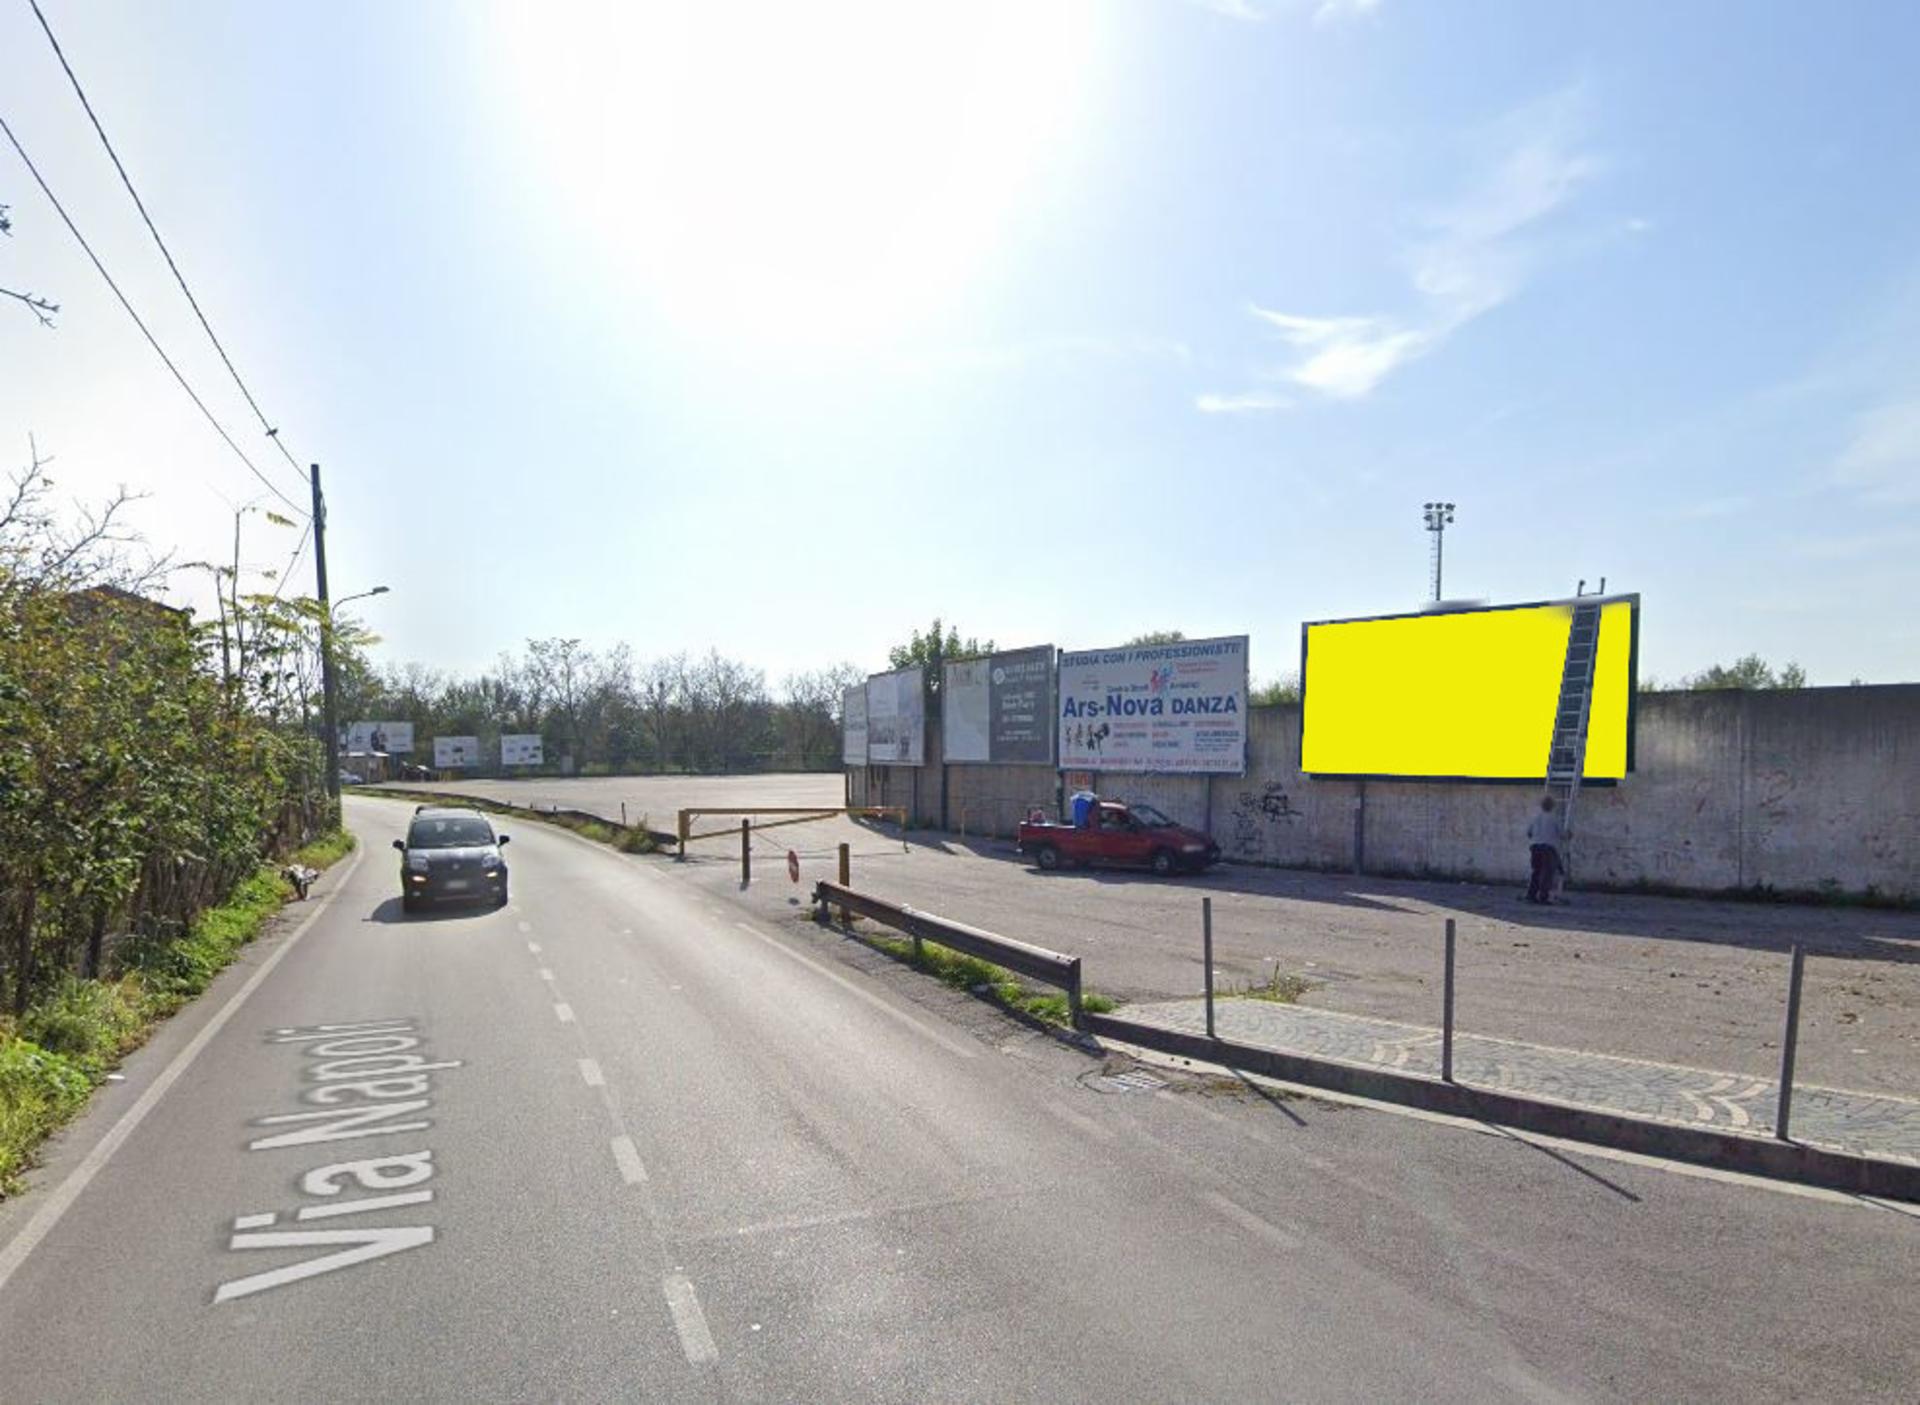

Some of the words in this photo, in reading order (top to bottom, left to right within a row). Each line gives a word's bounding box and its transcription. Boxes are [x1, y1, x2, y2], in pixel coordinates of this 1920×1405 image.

[1103, 653, 1126, 665] CON
[1063, 694, 1163, 718] Ars-Nova
[1172, 696, 1237, 714] DANZA
